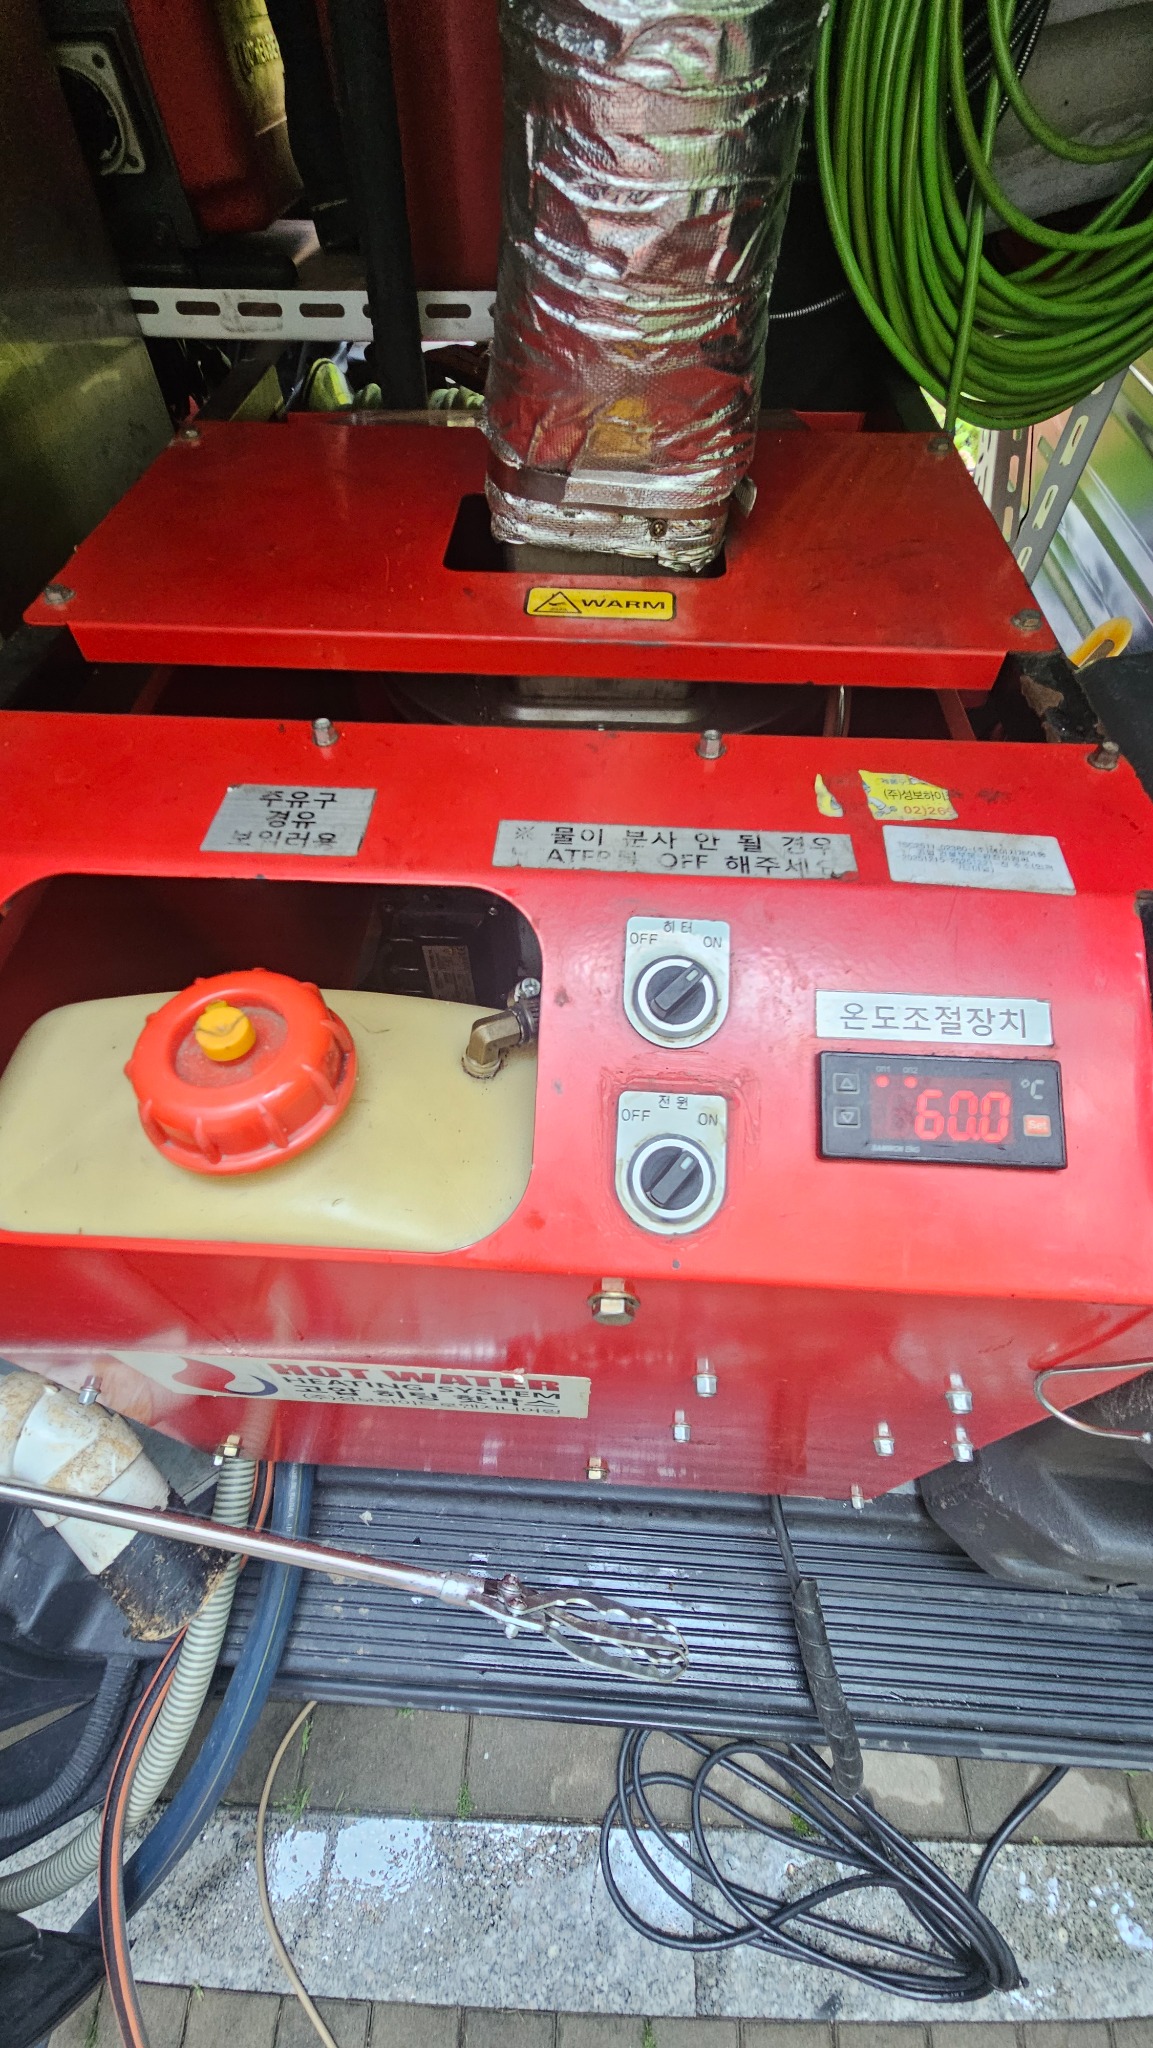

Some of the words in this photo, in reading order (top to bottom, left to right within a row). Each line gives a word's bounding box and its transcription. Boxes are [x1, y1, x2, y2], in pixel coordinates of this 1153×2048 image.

[581, 598, 666, 610] WARM
[259, 790, 338, 810] 주유구
[883, 788, 950, 801] (주)성보하이
[266, 810, 317, 829] 경유
[551, 826, 604, 846] 물이
[622, 829, 678, 848] 분사
[694, 832, 721, 851] 안
[737, 834, 763, 853] 될
[781, 836, 832, 856] 경우
[656, 851, 709, 871] OFF
[629, 932, 658, 945] OFF
[702, 935, 722, 949] ON
[839, 1001, 1027, 1039] 온도조절장치
[621, 1108, 651, 1122] OFF
[697, 1112, 719, 1126] ON
[267, 1363, 369, 1380] HOT
[382, 1370, 560, 1392] WATER
[282, 1376, 424, 1391] HEATING
[437, 1386, 561, 1400] SYSTEM
